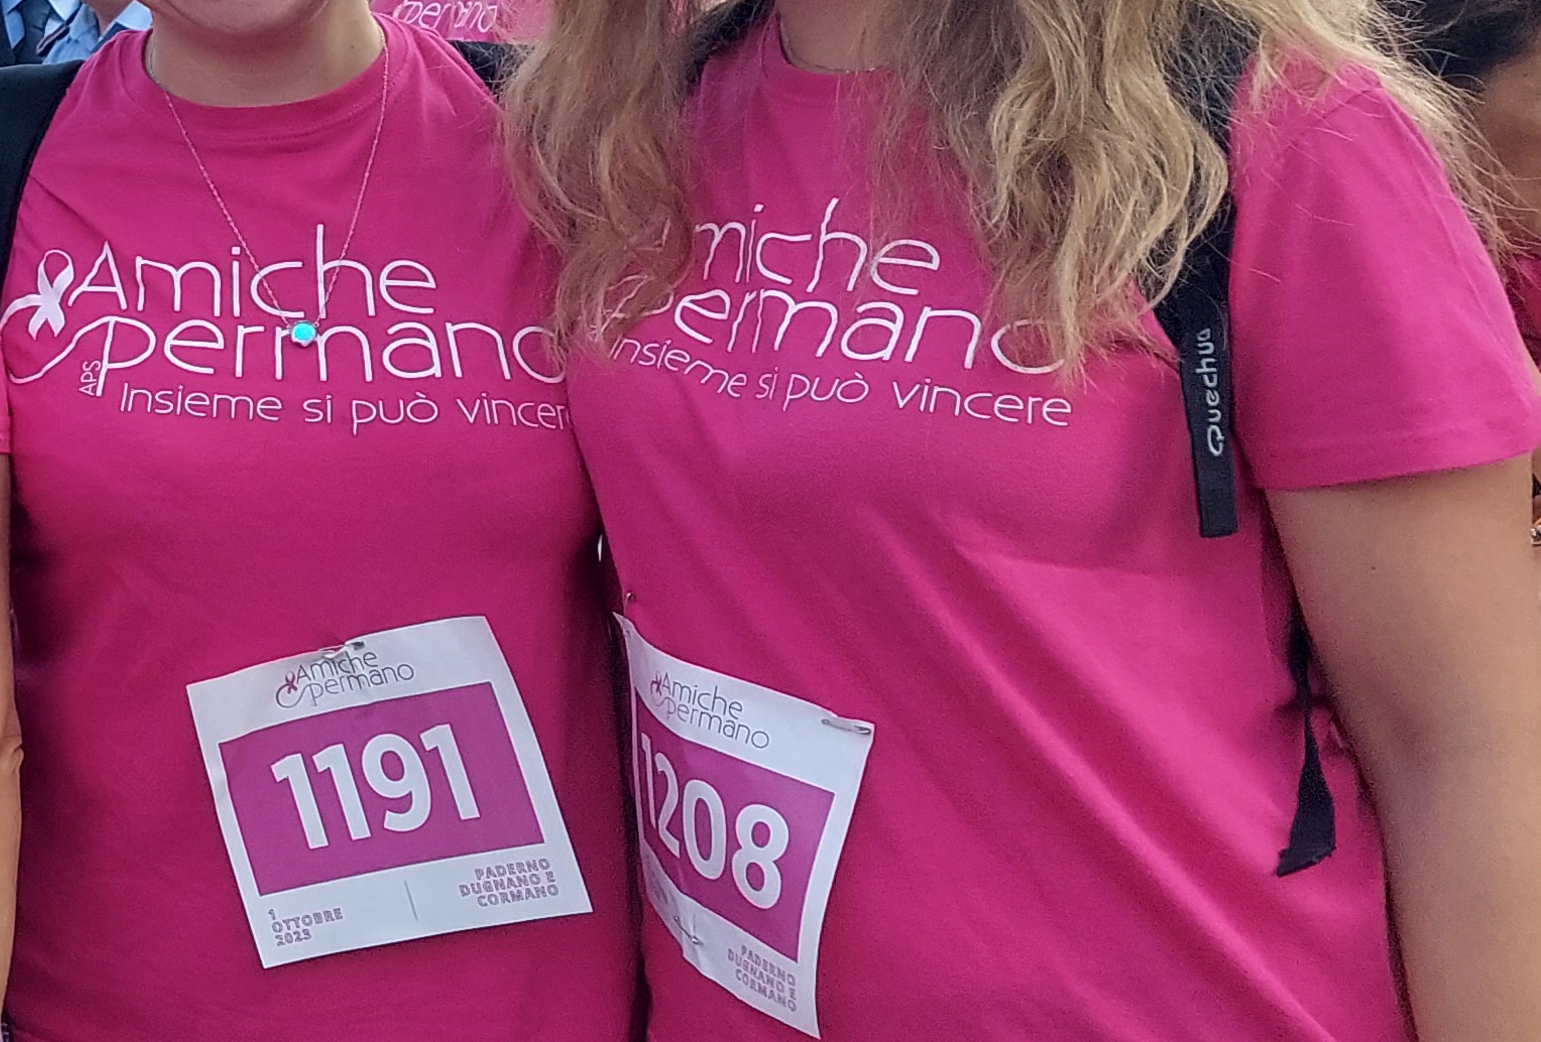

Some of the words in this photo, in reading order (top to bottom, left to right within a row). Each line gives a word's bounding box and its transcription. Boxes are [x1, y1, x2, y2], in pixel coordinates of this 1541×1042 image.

[639, 197, 940, 295] miche
[68, 223, 437, 319] Amiche
[78, 359, 102, 397] APS
[756, 366, 779, 400] si
[783, 371, 870, 412] può
[892, 378, 1072, 427] vincere
[1194, 327, 1225, 457] Quechua
[119, 381, 282, 423] Insieme
[303, 391, 333, 425] si
[352, 389, 439, 435] può
[456, 392, 571, 430] vincer
[296, 649, 379, 682] Amiche
[660, 672, 744, 721] Amiche
[270, 723, 481, 850] 1191
[640, 731, 790, 910] 1208
[459, 873, 541, 898] DUGNANO
[474, 857, 551, 882] PADERNO
[477, 883, 560, 908] CORMANO
[271, 908, 344, 934] OTTOBRE
[276, 928, 312, 947] 2023
